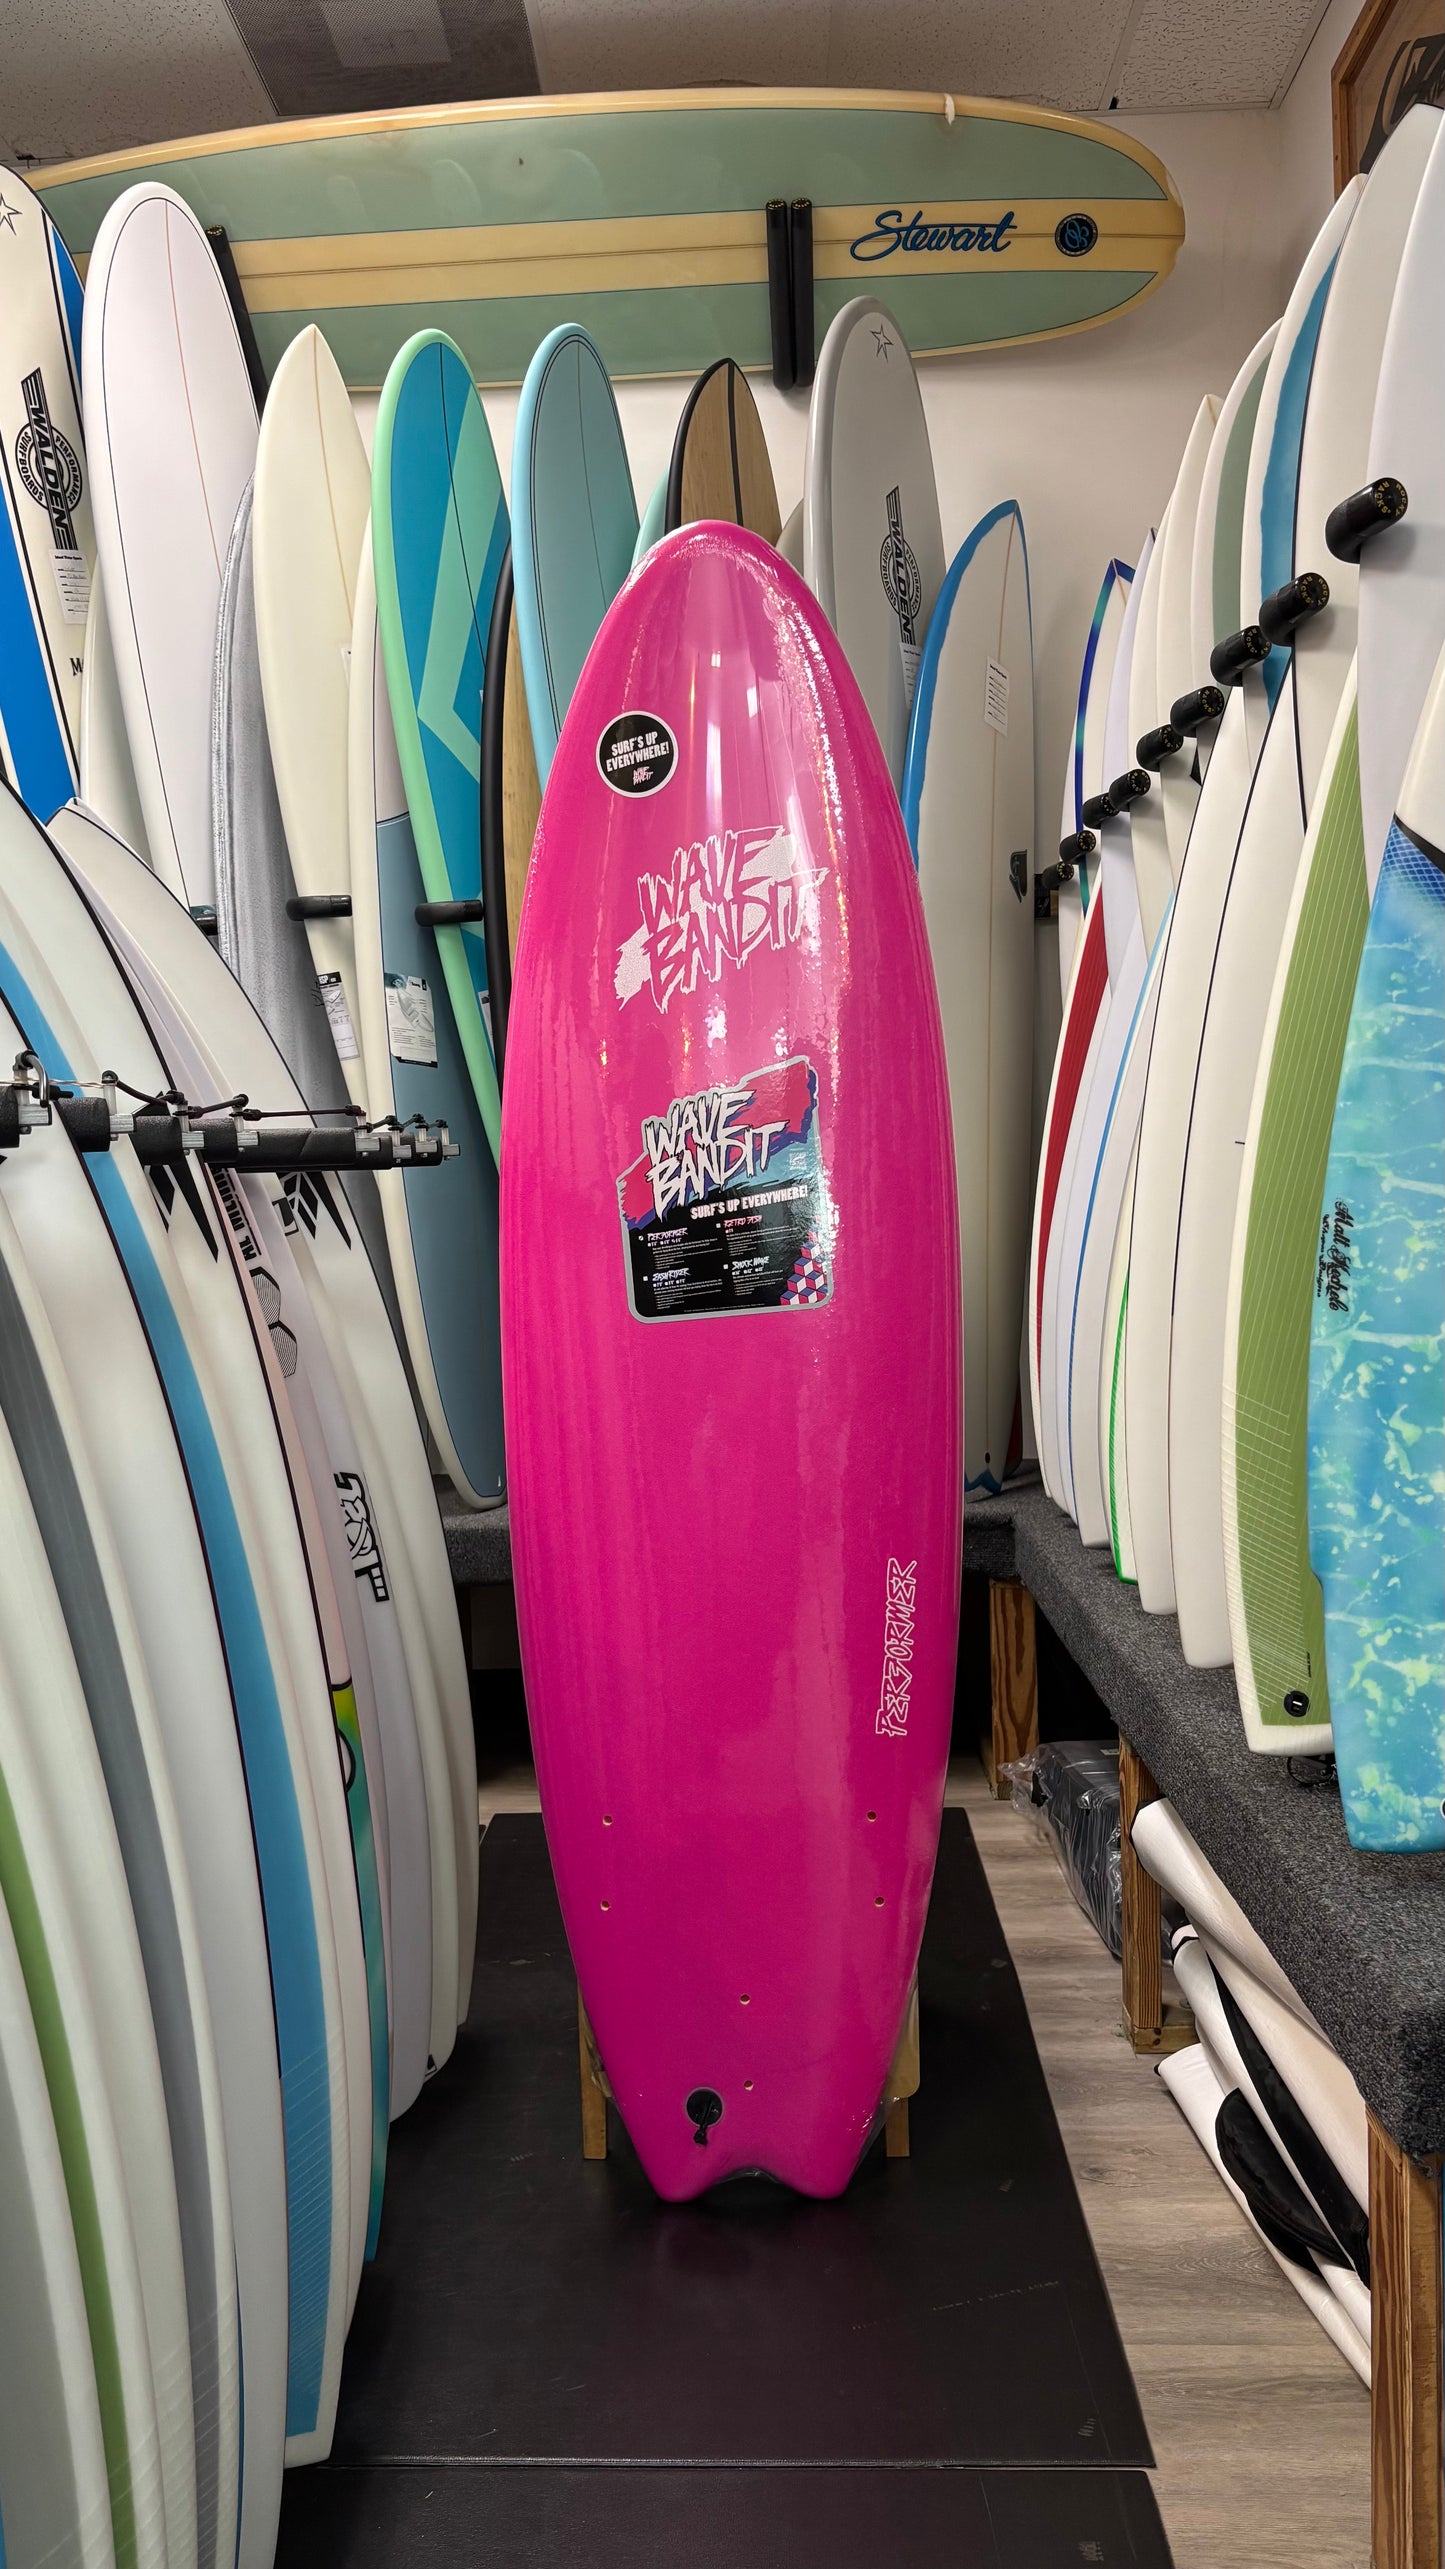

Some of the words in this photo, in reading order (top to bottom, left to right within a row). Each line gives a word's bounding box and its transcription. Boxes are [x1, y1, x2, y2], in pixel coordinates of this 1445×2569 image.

[850, 210, 1018, 261] Stewart
[18, 430, 44, 502] SURFBOARDS
[29, 402, 68, 533] WALDEN
[55, 434, 82, 506] PERFORMANCE
[890, 518, 914, 636] WALDEN
[606, 741, 669, 772] EVERYWHERE!
[611, 735, 645, 756] SURF'S
[645, 731, 658, 746] UP
[637, 825, 786, 935] WAVE
[640, 866, 831, 1014] BANDIT
[645, 1089, 756, 1166] WAVE
[645, 1120, 790, 1223] BANDIT
[690, 1201, 725, 1220] SURF'S
[727, 1198, 740, 1213] UP
[742, 1185, 808, 1210] EVERYWHERE!
